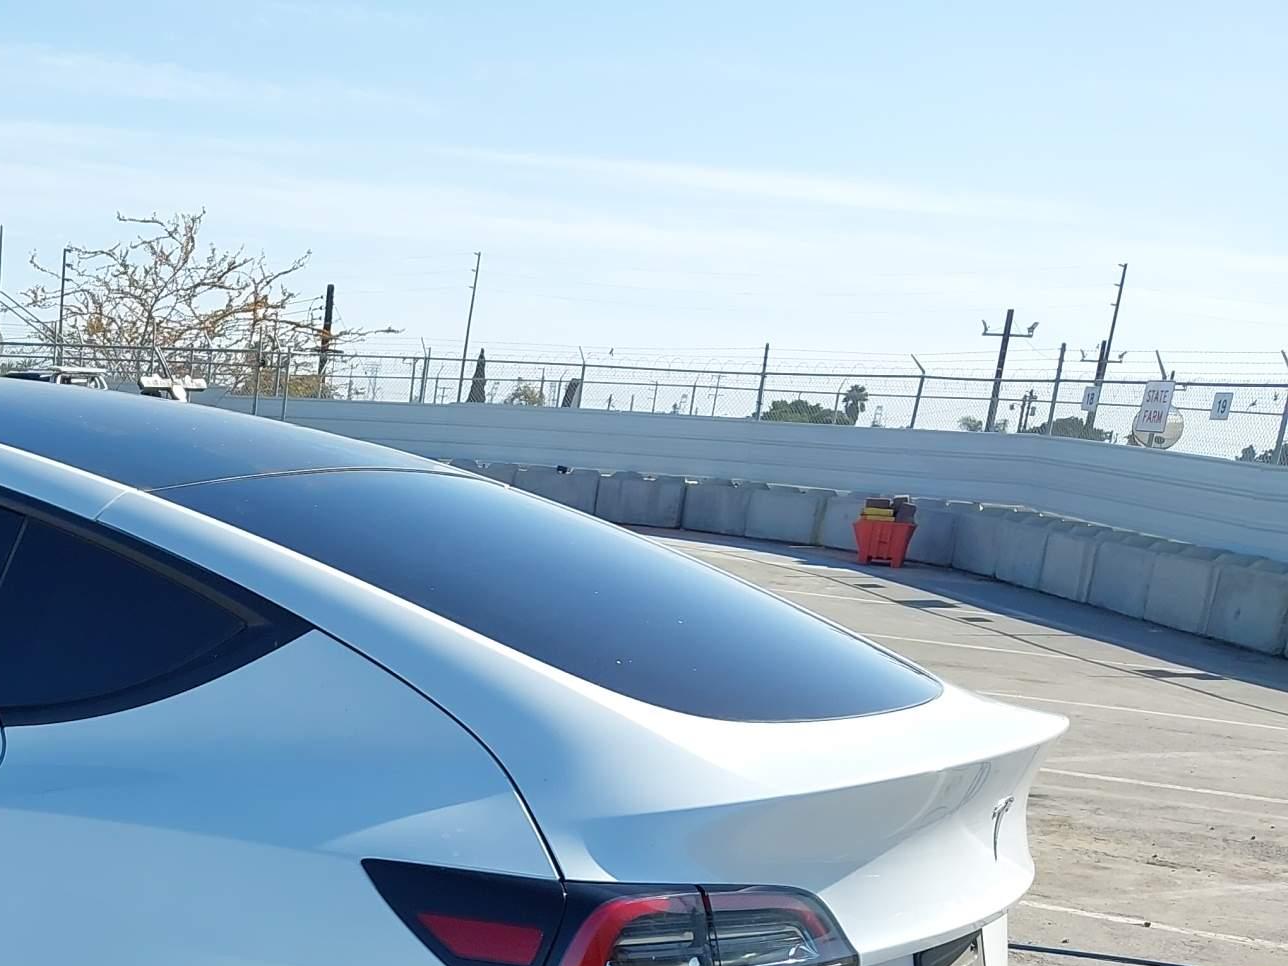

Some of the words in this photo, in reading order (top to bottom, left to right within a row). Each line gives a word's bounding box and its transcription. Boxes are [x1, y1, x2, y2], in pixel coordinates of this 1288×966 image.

[1146, 390, 1169, 404] STATE
[1217, 399, 1227, 414] 19
[1142, 410, 1164, 424] FARM
